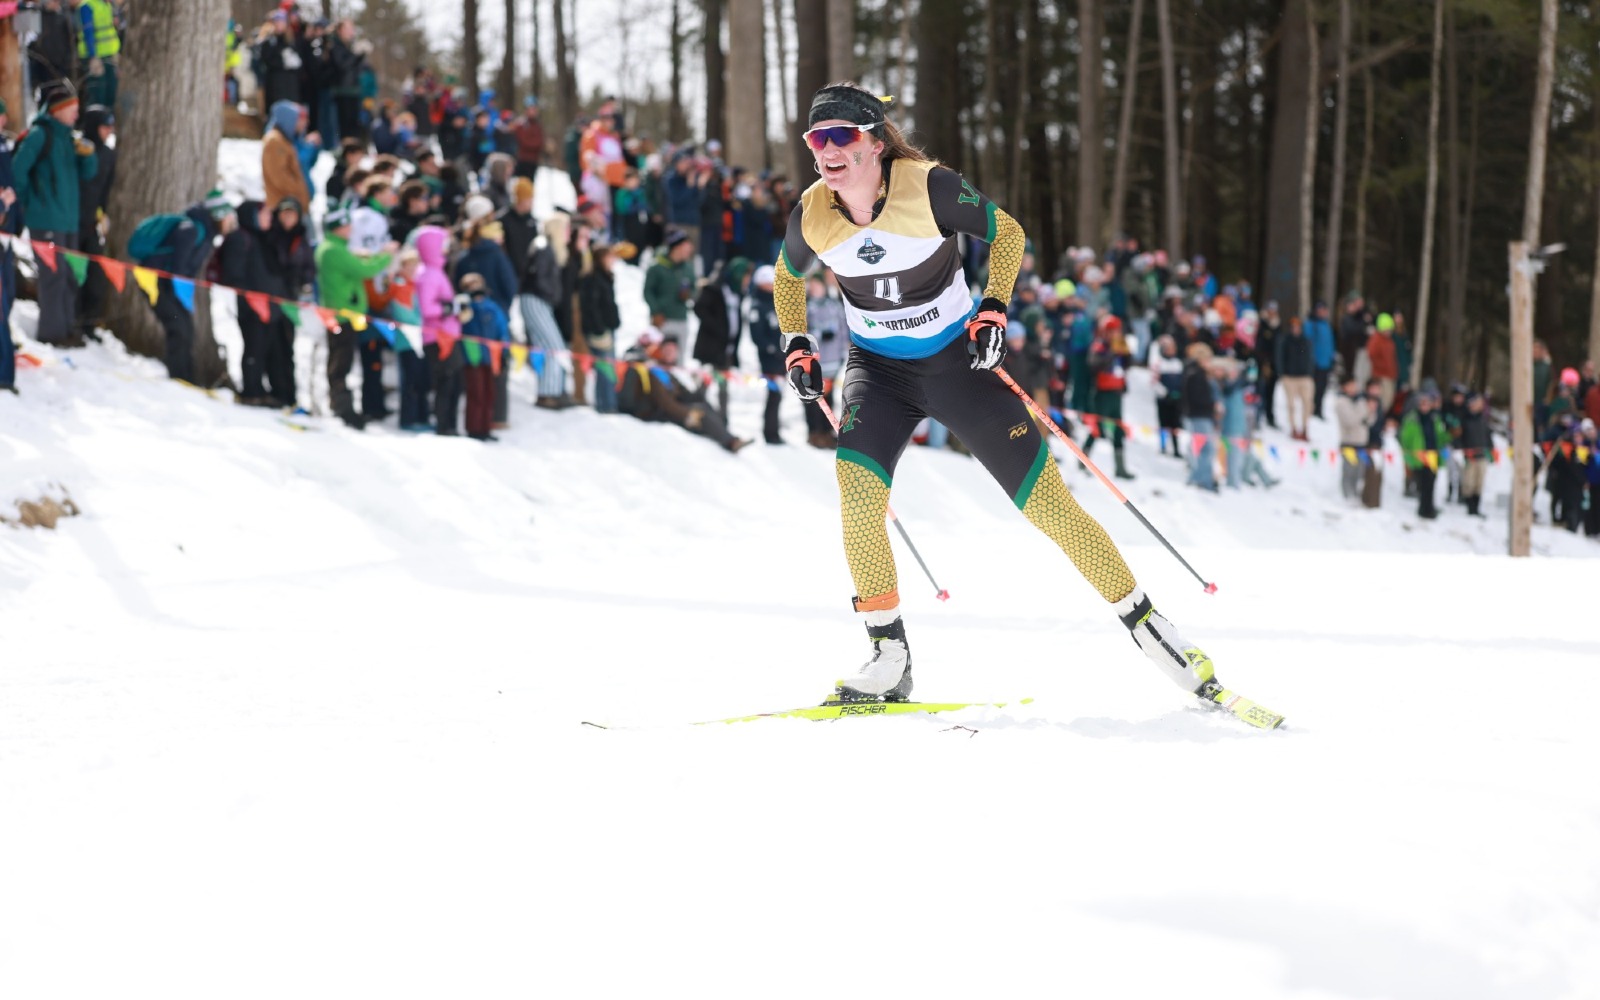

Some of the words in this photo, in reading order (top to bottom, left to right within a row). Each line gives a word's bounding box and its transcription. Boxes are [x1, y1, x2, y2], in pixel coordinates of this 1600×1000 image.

[958, 178, 980, 207] V
[873, 276, 903, 306] 4
[839, 704, 887, 716] FISCHER
